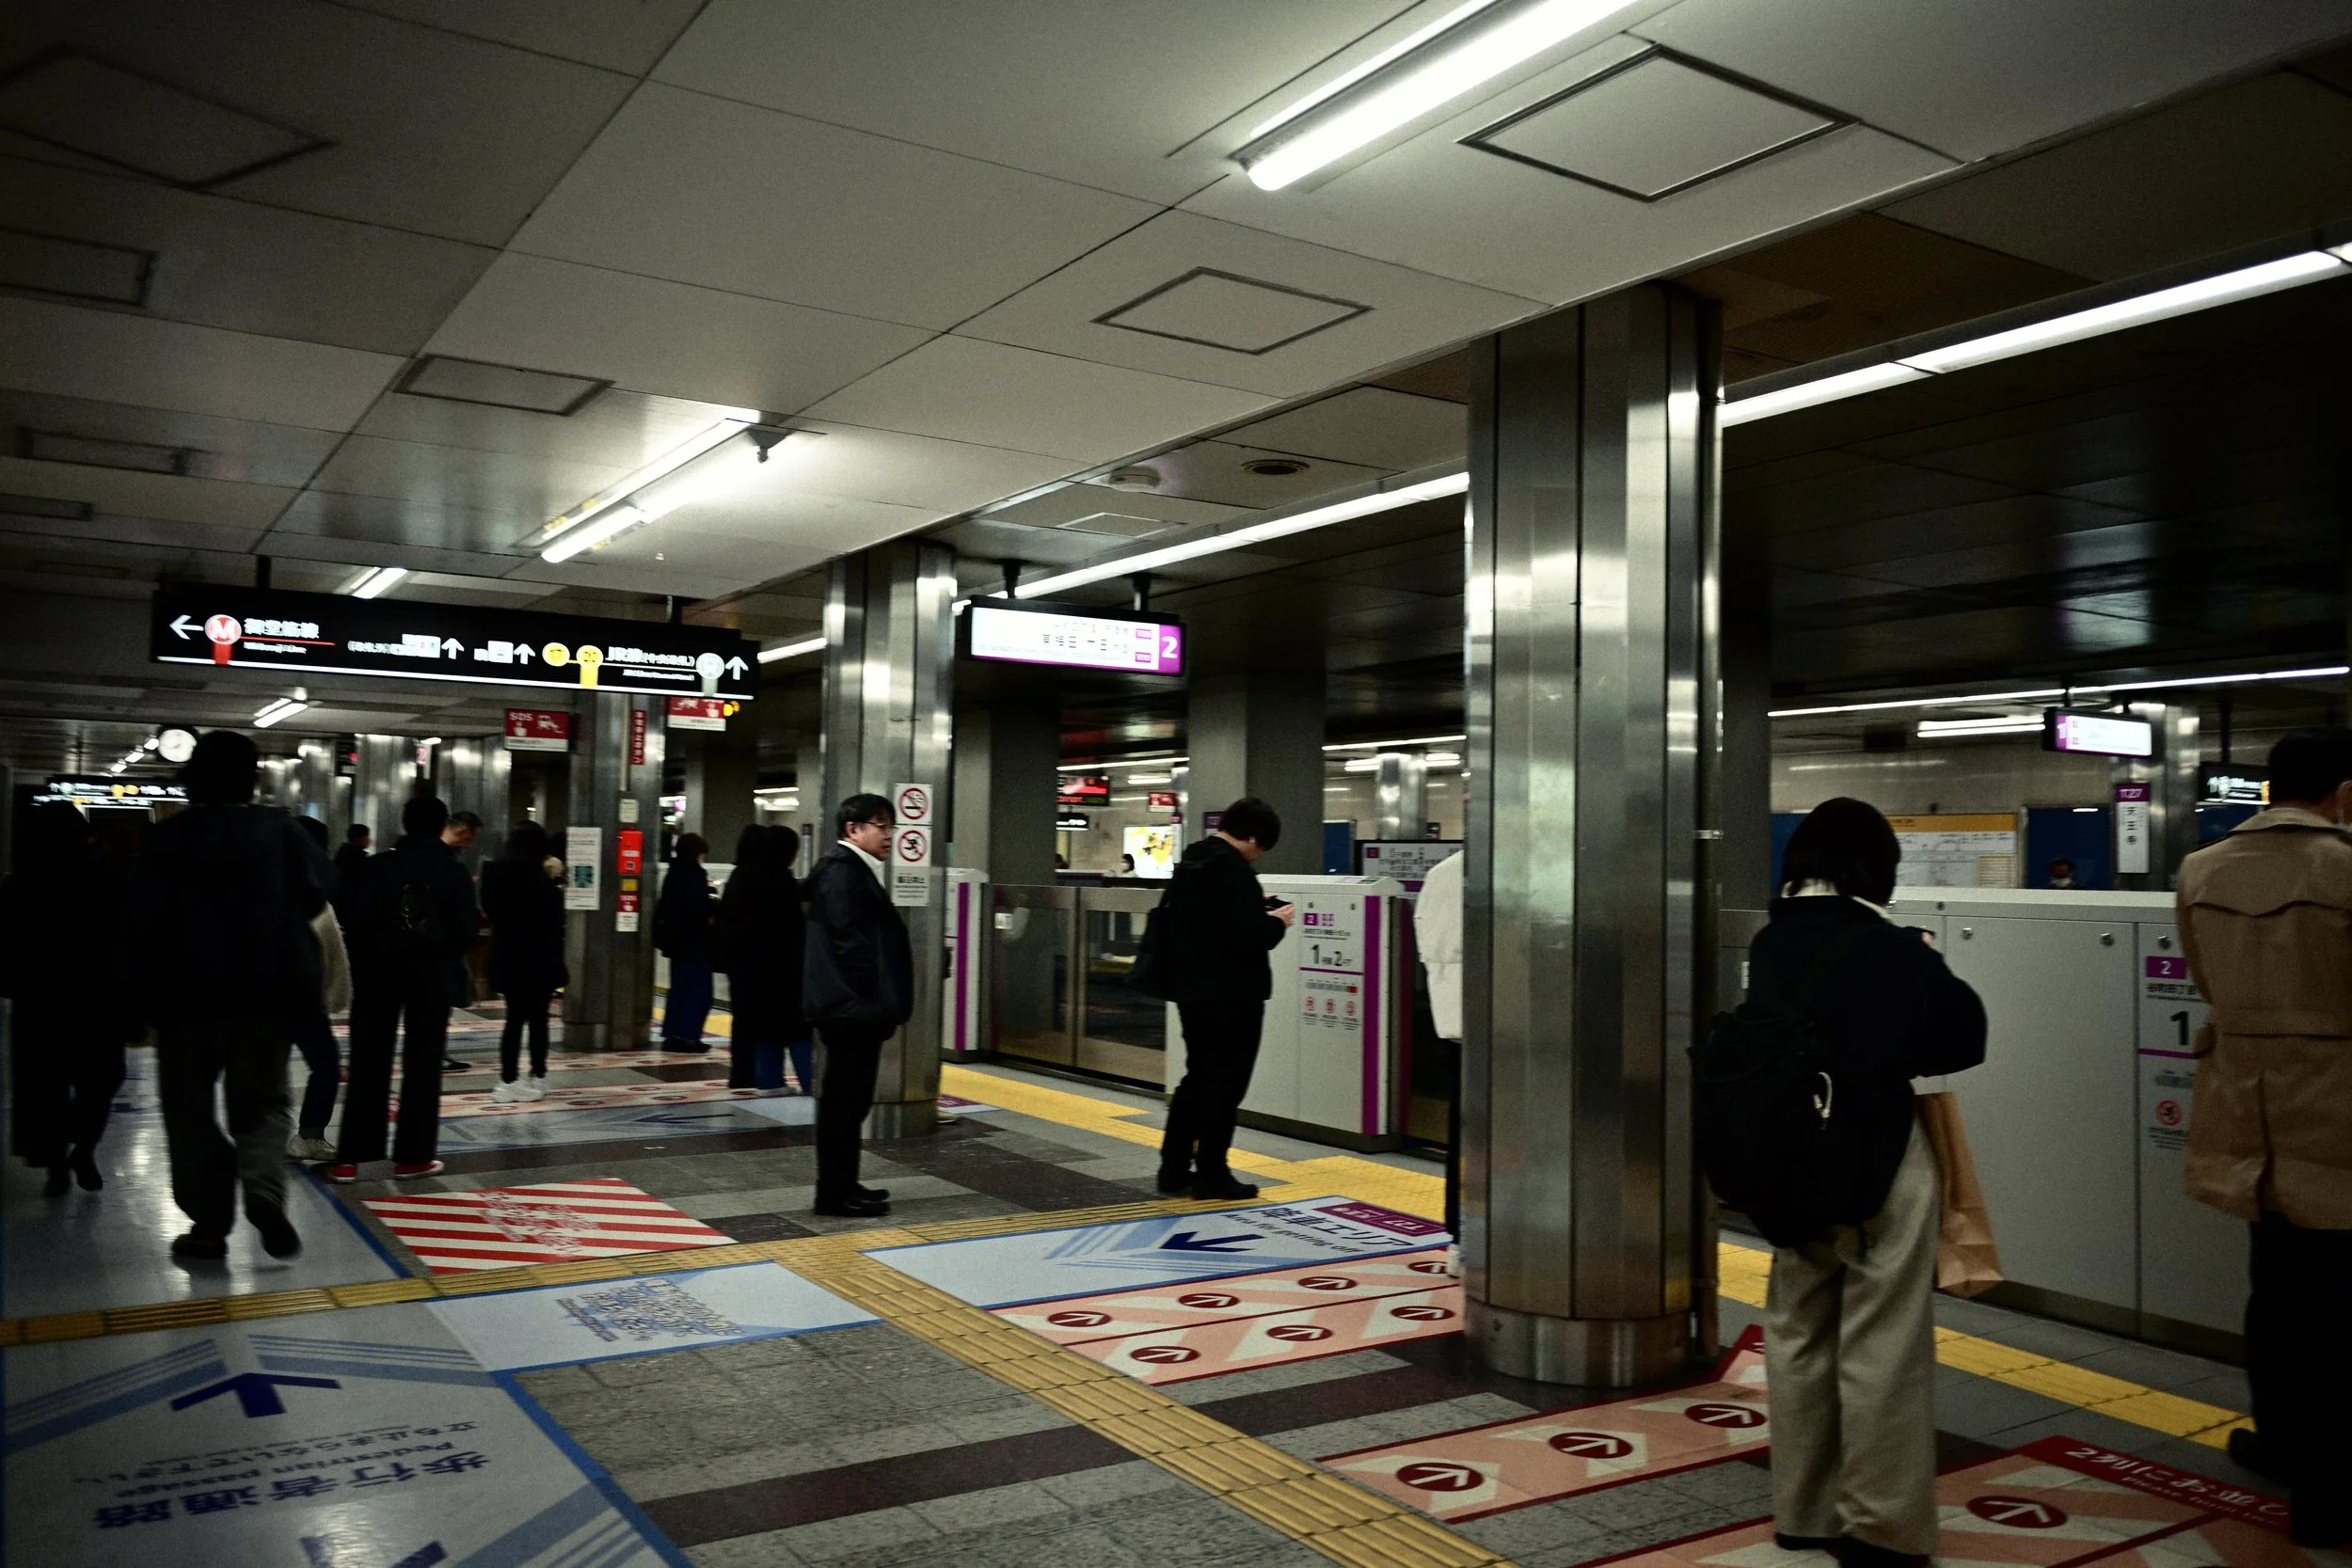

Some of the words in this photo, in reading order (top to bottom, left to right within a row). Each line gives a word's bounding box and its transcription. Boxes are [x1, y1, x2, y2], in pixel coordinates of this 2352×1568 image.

[1161, 636, 1178, 658] 2
[508, 711, 534, 721] SOS
[1307, 914, 1316, 925] 2
[2160, 960, 2172, 975] 2
[2169, 1010, 2190, 1046] 1
[1248, 1206, 1415, 1247] 降車エリア
[1271, 1229, 1333, 1247] getting
[1329, 1244, 1366, 1254] off
[71, 1421, 479, 1485] 立ち止まらないで下さい
[271, 1441, 453, 1475] Pedestrian
[93, 1450, 490, 1529] 歩行者通路
[115, 1467, 262, 1498] passage
